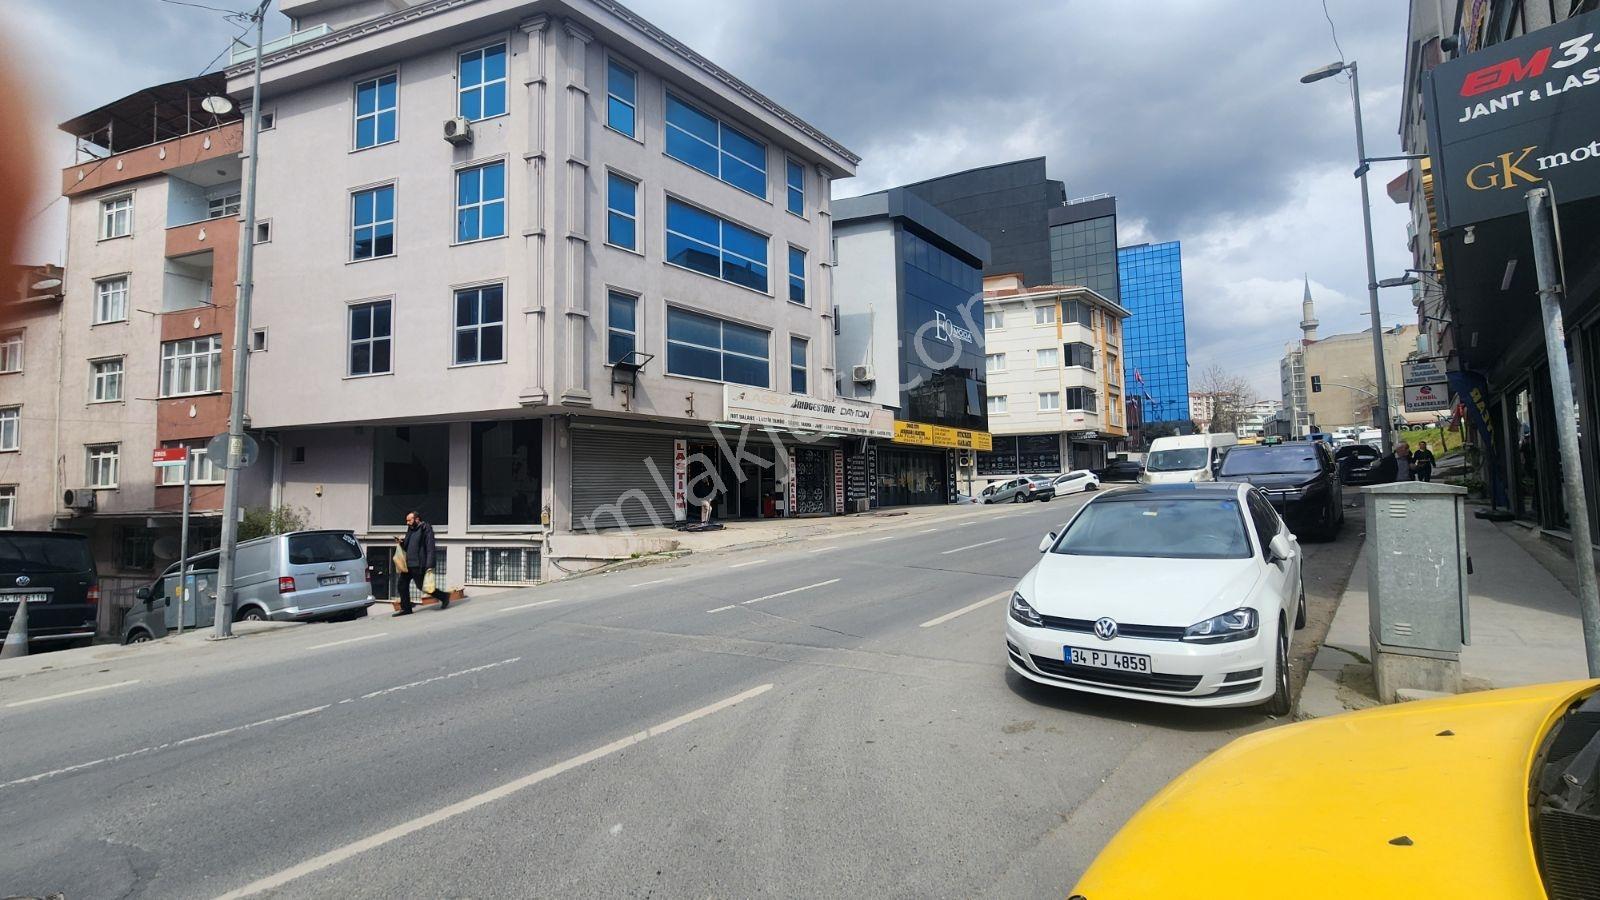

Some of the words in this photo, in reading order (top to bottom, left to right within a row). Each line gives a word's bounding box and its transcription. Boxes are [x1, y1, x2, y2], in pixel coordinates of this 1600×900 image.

[1458, 90, 1524, 123] JANT
[1529, 89, 1541, 102] &
[1545, 67, 1600, 97] LAS
[1466, 146, 1543, 190] GK
[840, 407, 870, 419] DAYTON
[1072, 650, 1087, 663] 34
[1092, 652, 1108, 667] PJ
[1113, 655, 1147, 672] 4859
